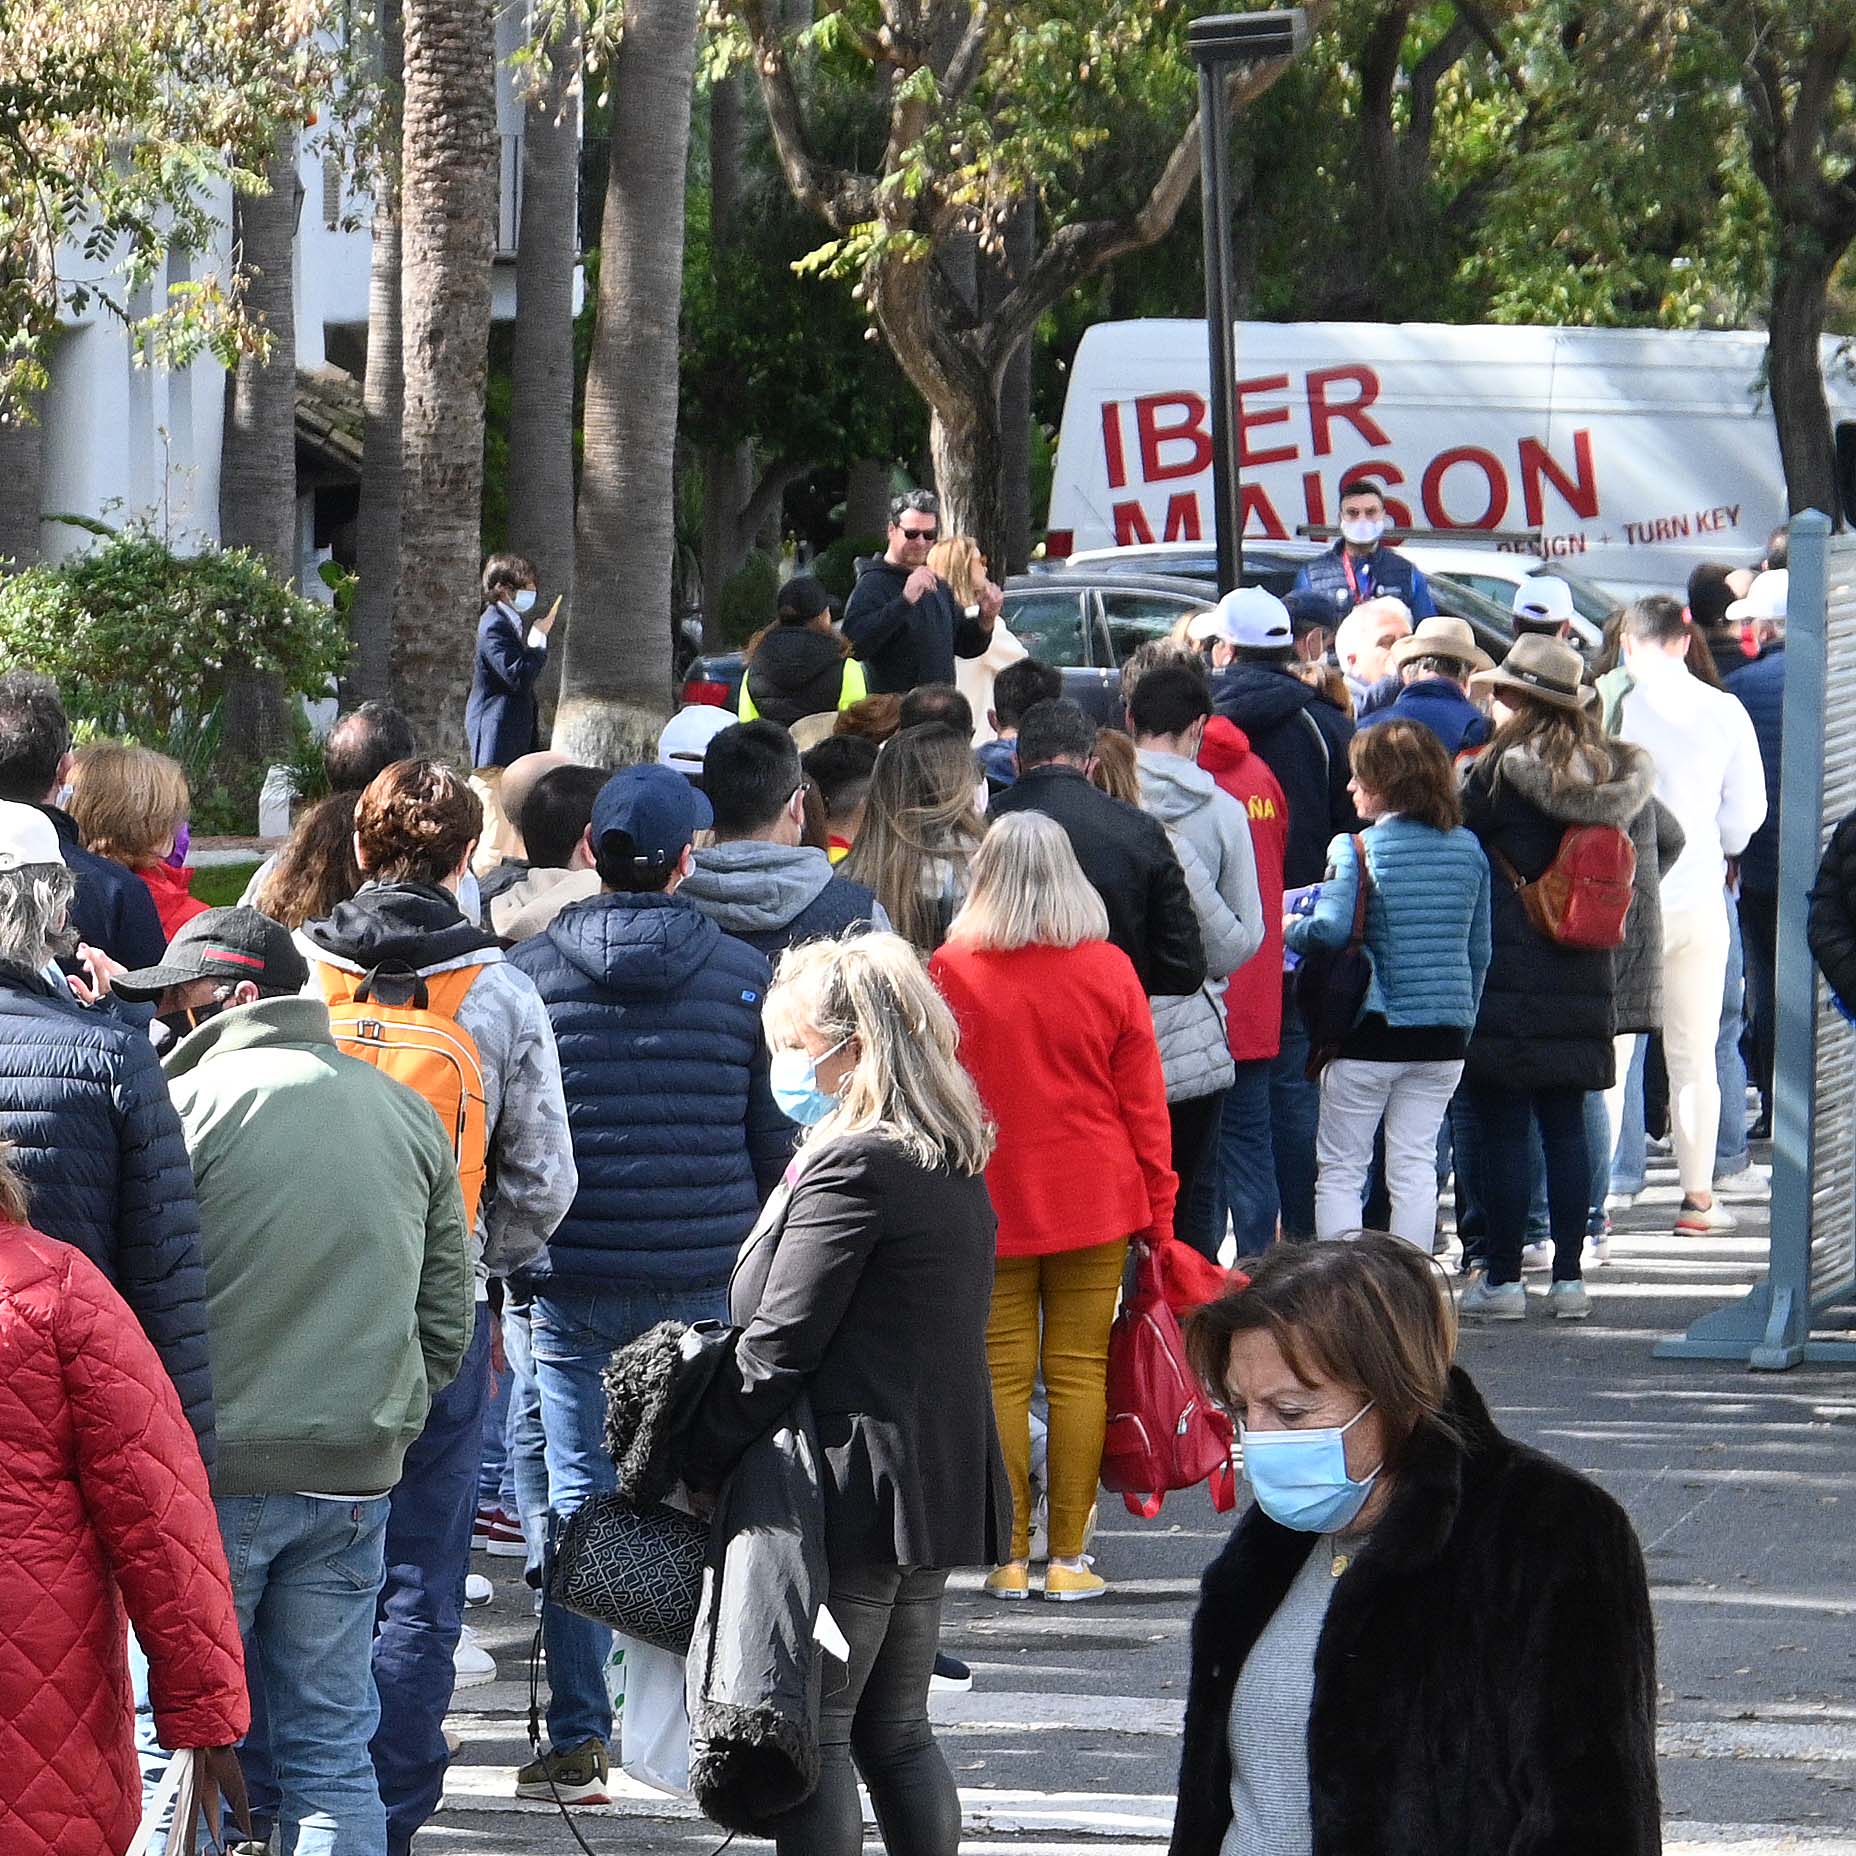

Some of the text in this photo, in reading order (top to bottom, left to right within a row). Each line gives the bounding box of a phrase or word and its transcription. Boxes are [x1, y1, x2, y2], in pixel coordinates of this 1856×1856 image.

[1101, 363, 1392, 489] IBER
[1111, 428, 1600, 547] MAISON
[1622, 513, 1690, 545] TURN
[1696, 504, 1740, 533] KEY
[1248, 794, 1276, 819] ÑA
